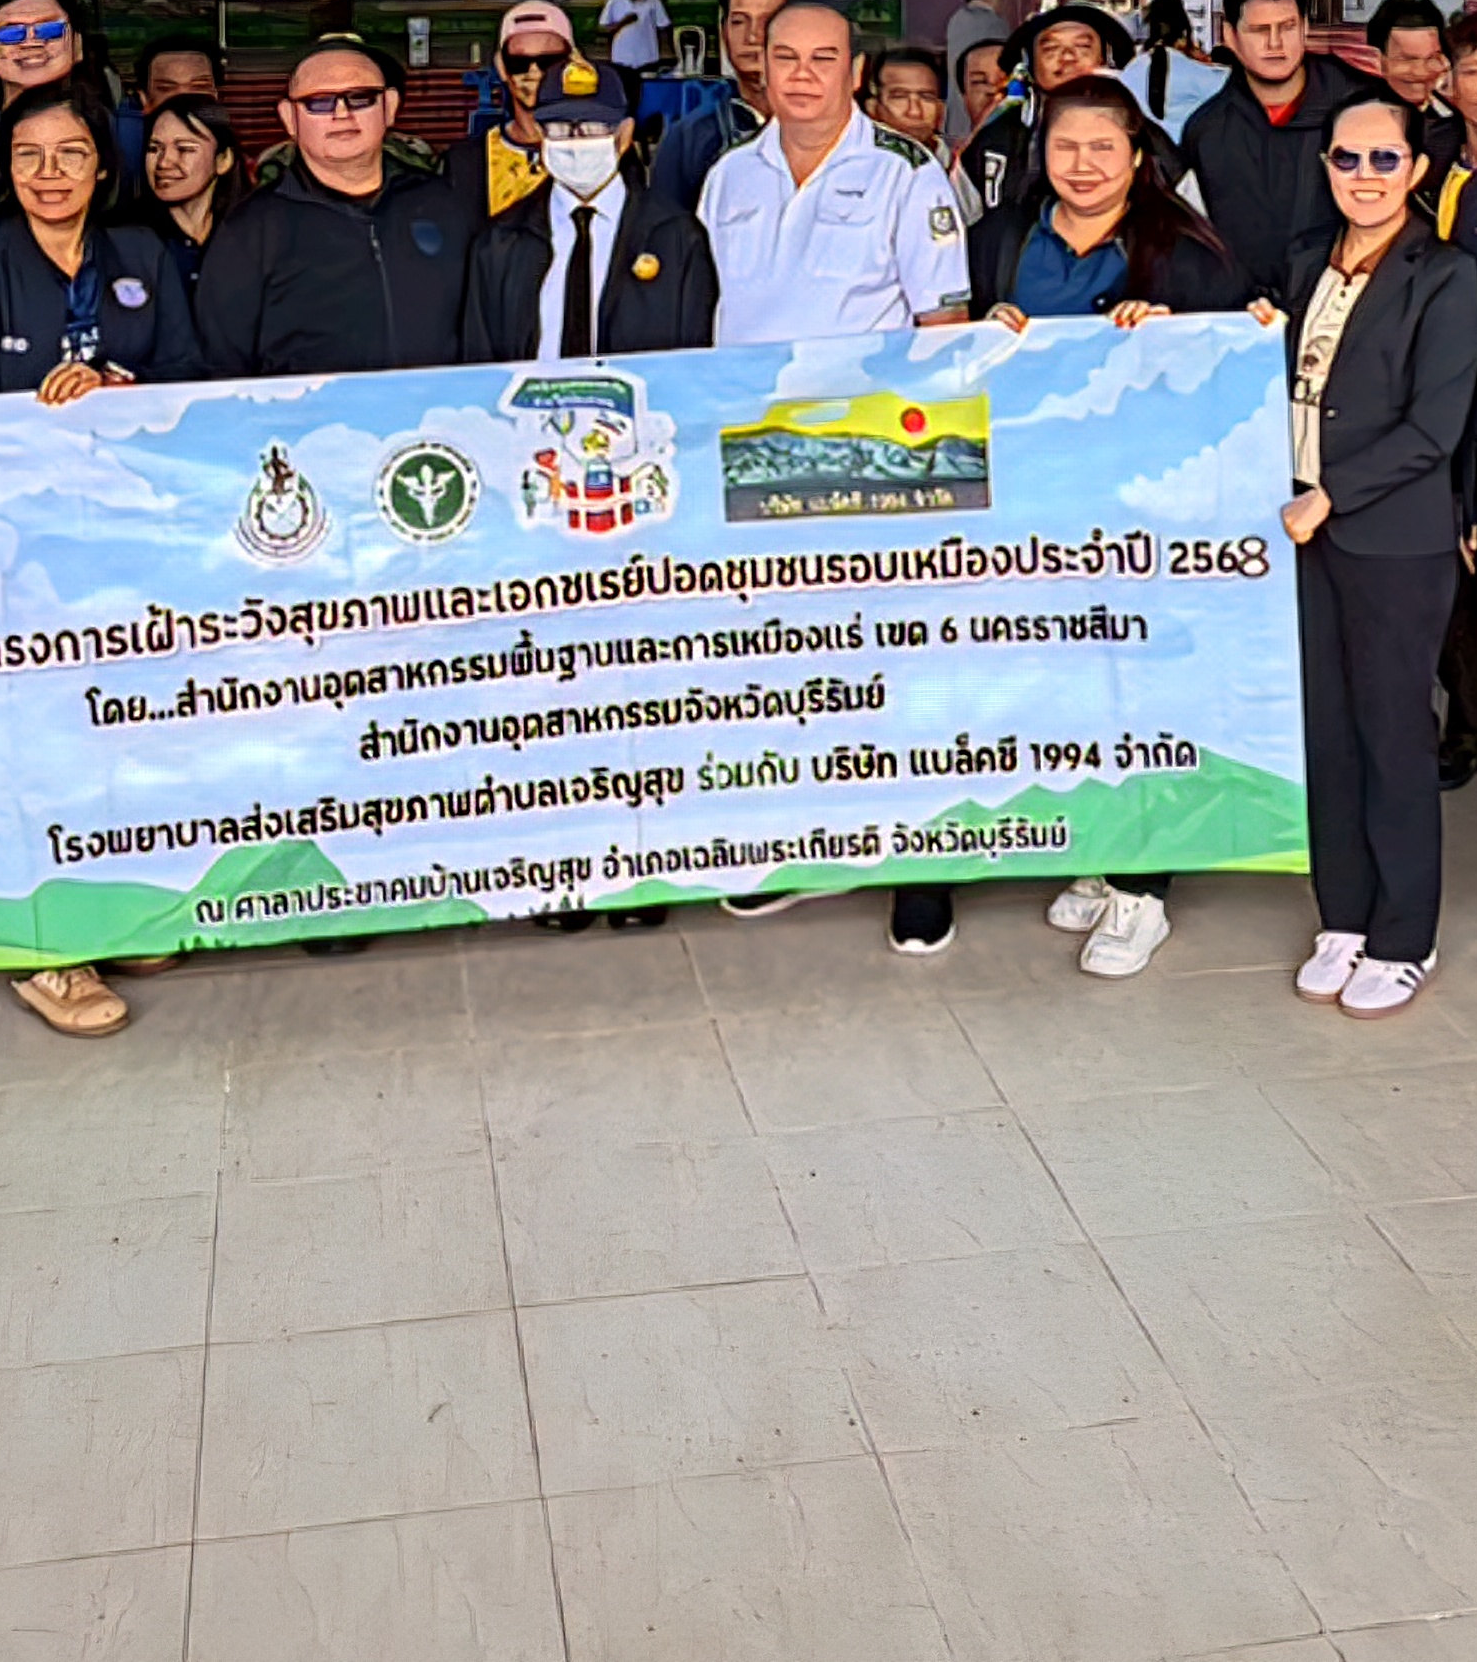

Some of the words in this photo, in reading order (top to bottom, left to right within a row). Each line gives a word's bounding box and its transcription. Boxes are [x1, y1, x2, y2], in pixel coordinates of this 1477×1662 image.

[1168, 535, 1270, 578] 2568
[874, 619, 928, 648] เขต
[939, 616, 959, 644] 6
[969, 604, 1148, 645] นครราชสีมา
[697, 754, 799, 792] ร่วมกับ
[810, 743, 899, 784] บริษัท
[1028, 740, 1103, 772] 1994
[1113, 731, 1198, 770] จำกัด
[194, 896, 224, 925] ณ
